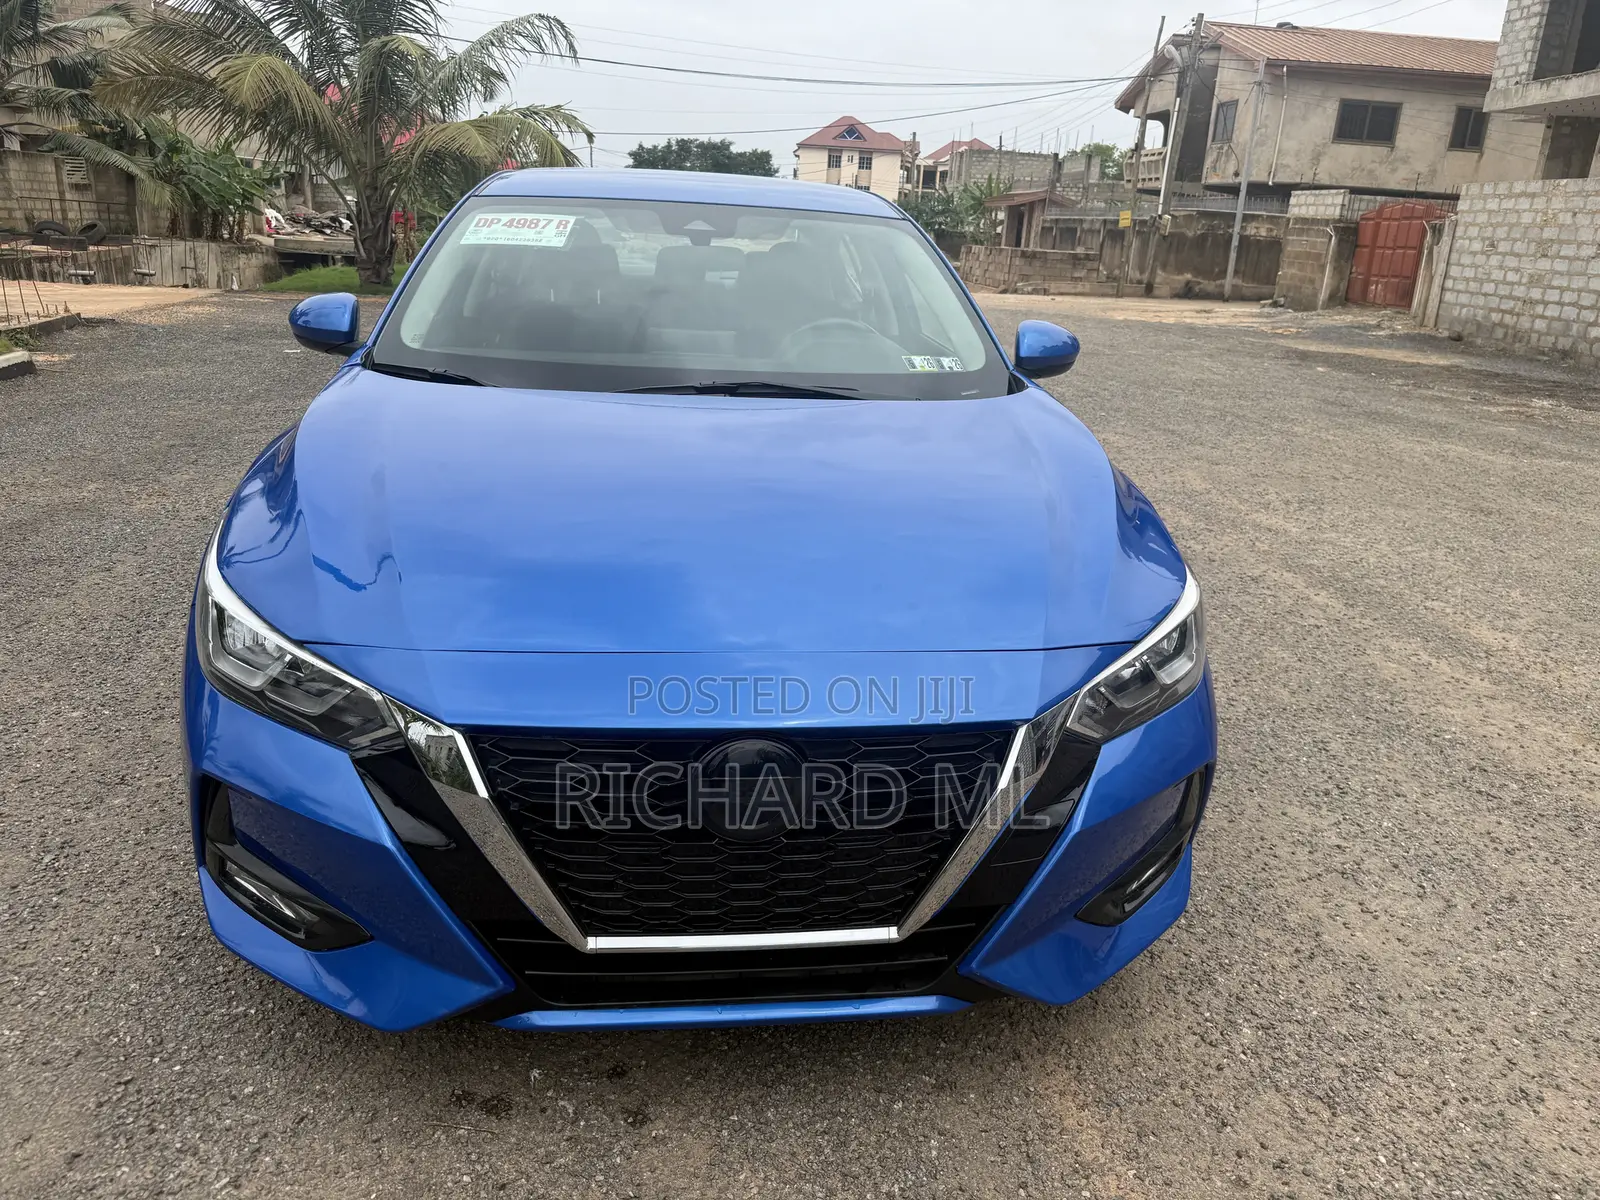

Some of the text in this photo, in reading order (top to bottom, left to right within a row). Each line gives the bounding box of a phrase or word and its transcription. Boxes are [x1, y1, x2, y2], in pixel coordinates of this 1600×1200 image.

[474, 217, 571, 230] DP 4987 R
